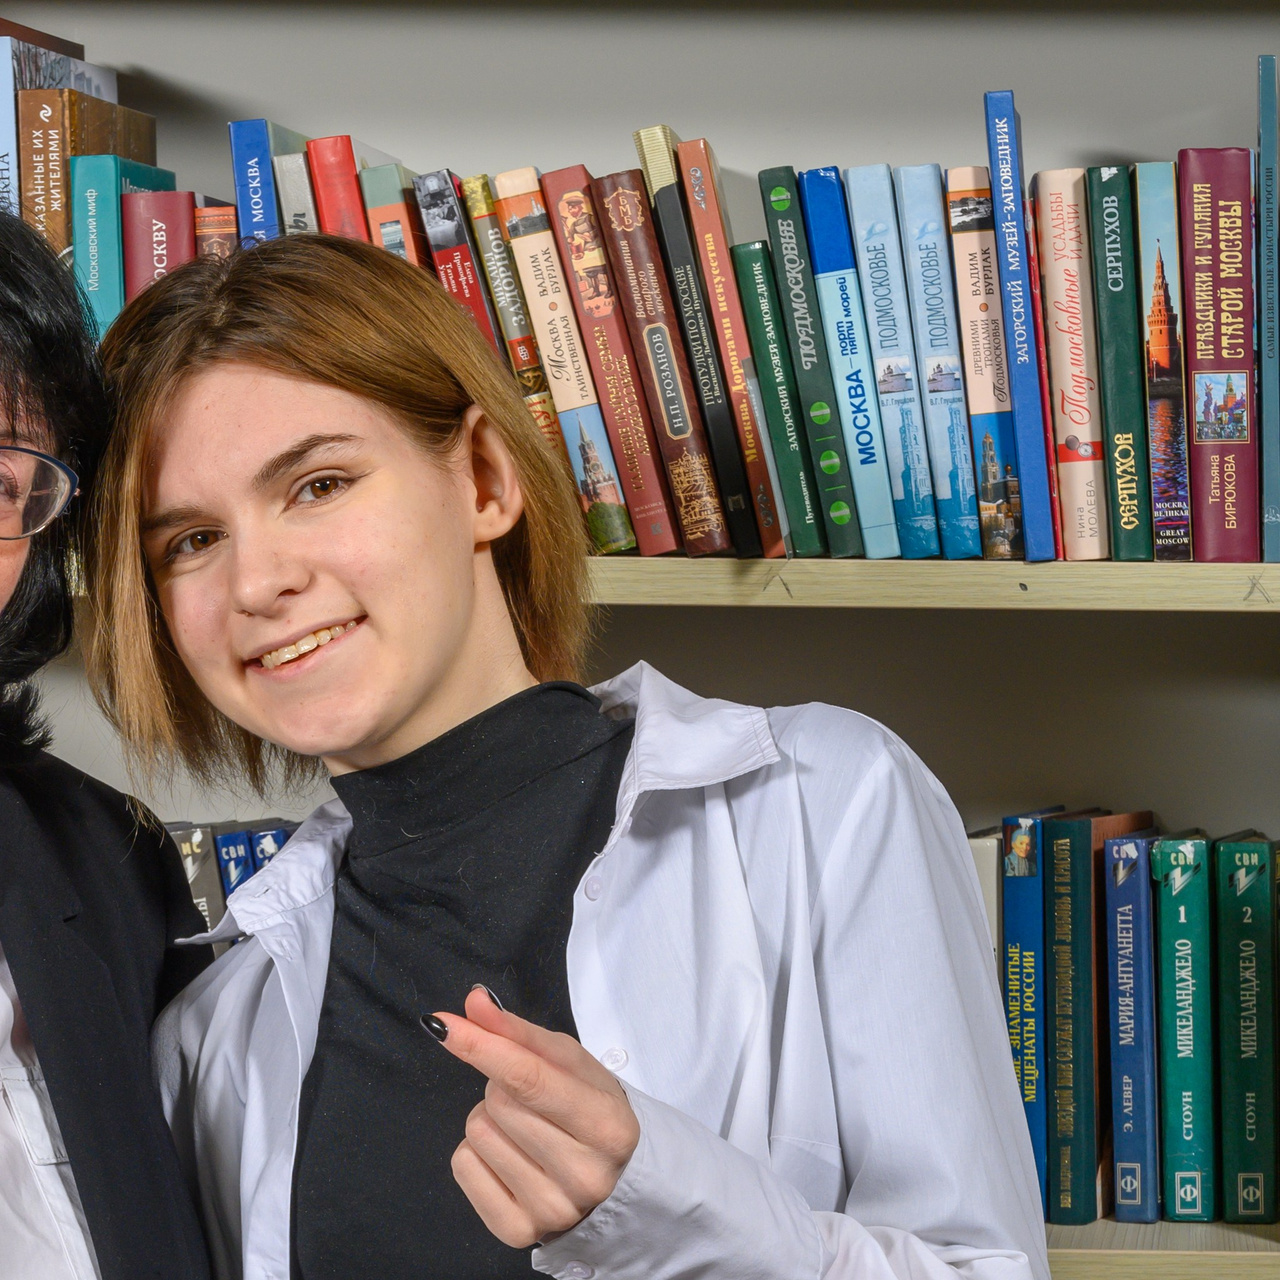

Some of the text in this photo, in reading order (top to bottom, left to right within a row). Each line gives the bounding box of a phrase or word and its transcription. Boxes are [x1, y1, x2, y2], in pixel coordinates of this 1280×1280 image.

[48, 129, 62, 211] ЖИТЕЛЯМИ
[247, 157, 265, 222] МОСКВА
[540, 246, 561, 295] БУРЛАК
[704, 232, 728, 312] искусства
[981, 246, 995, 296] БУРЛАК
[995, 117, 1030, 364] ЗАГОРСКИЙ МУЗЕЙ-ЗАПОВЕДНИК
[1102, 195, 1124, 292] СЕРПУХОВ
[446, 263, 458, 294] Татьяна
[453, 251, 471, 299] Прокофьева
[463, 261, 475, 285] Елена
[484, 252, 508, 307] МИХАИЛ
[488, 227, 525, 327] ЗАДОРНОВ
[530, 253, 549, 298] ВАДИМ
[620, 240, 647, 318] Воспоминания
[637, 270, 656, 317] старого
[646, 263, 667, 315] москвича
[866, 243, 898, 350] ПОДМОСКОВЬЕ
[918, 241, 948, 349] ПОДМОСКОВЬЕ
[968, 252, 981, 297] ВАДИМ
[1217, 200, 1245, 359] СТАРОЙ МОСКВЫ
[1049, 191, 1096, 426] Подмосковные УСАДЬБЫ
[721, 318, 745, 394] Дорогами
[970, 320, 984, 376] ДРЕВНИМИ
[979, 318, 990, 368] ТРОПАМИ
[739, 399, 759, 463] Москва.
[846, 368, 877, 466] МОСКВА
[1086, 479, 1098, 538] МОЛЕВА
[1114, 432, 1140, 530] СЕРПУХОВ
[1155, 501, 1188, 509] МОСКВА
[1209, 454, 1220, 504] Татьяна
[1224, 454, 1237, 529] БИРЮКОВА
[1076, 505, 1086, 539] Нина
[1156, 537, 1190, 545] MOSCOW
[1117, 904, 1134, 1046] МАРИЯ-АНТУАНЕТТА
[1175, 939, 1197, 1058] МИКЕЛАНДЖЕЛО
[1239, 940, 1261, 1059] МИКЕЛАНДЖЕЛО
[1022, 951, 1040, 1102] МЕЦЕНАТЫ РОССИИ
[1182, 1091, 1194, 1141] СТОУН
[1245, 1092, 1256, 1142] СТОУН
